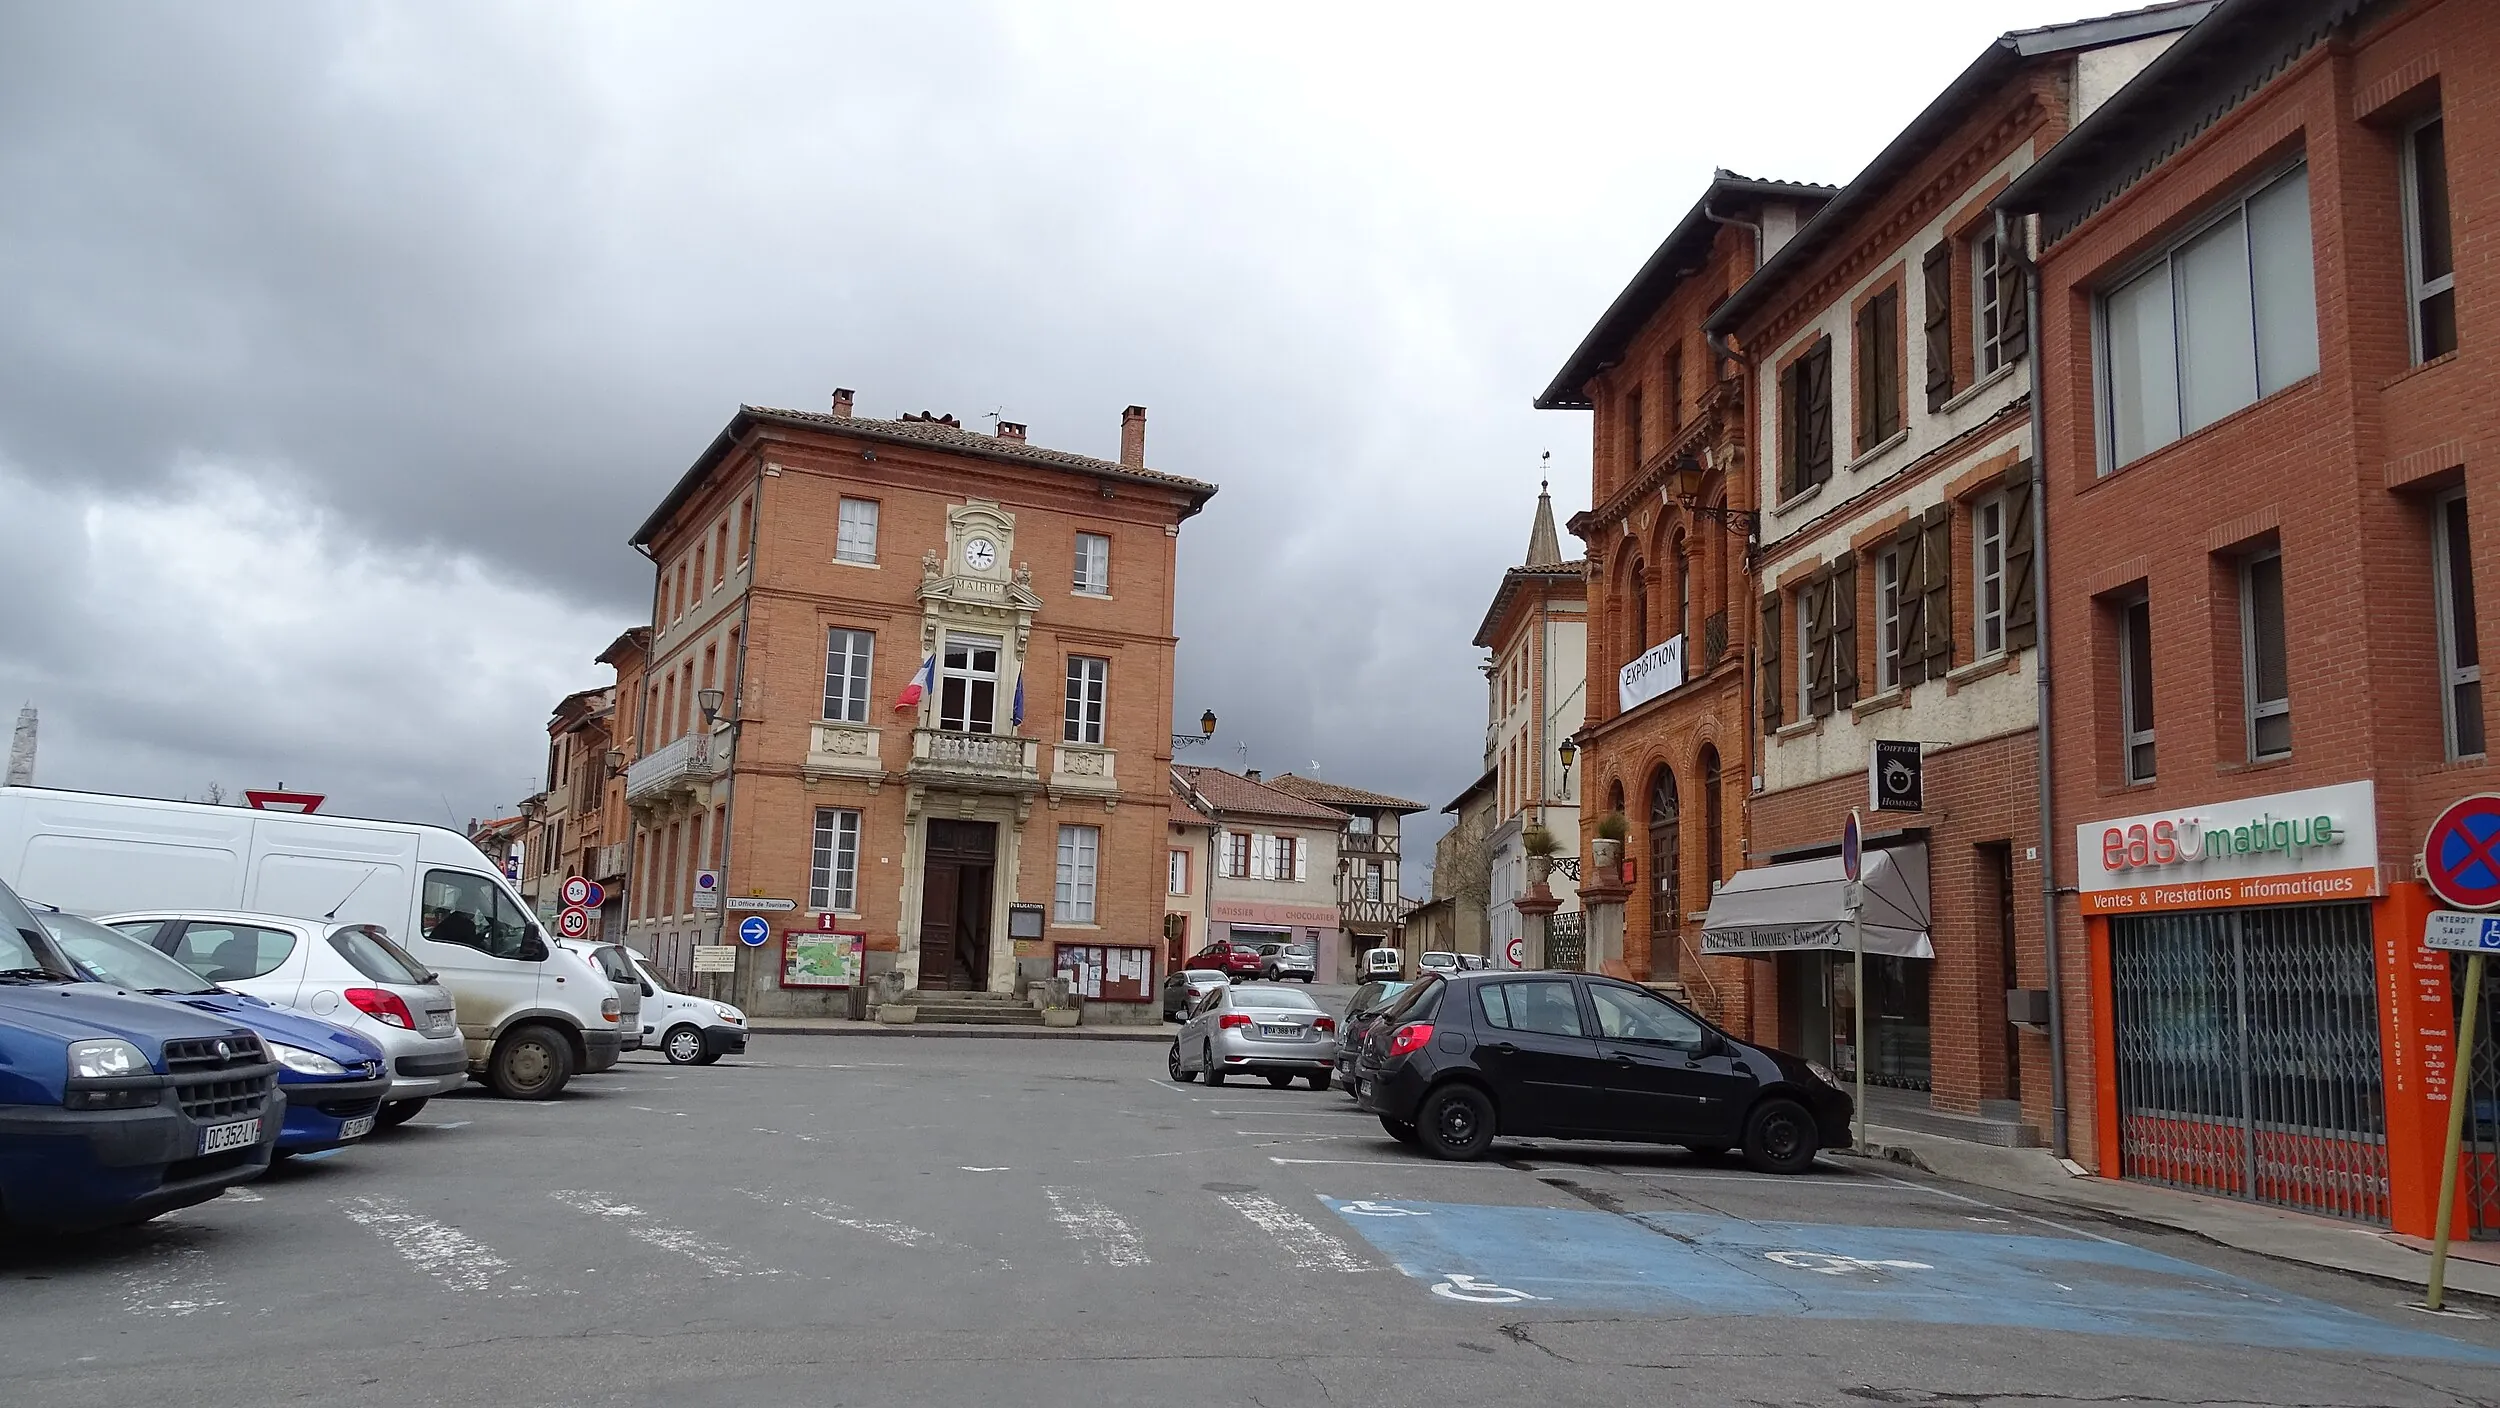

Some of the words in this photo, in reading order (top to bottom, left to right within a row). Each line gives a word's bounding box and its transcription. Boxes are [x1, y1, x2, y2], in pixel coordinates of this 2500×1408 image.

[957, 579, 1001, 594] MAIRIE
[1625, 642, 1676, 686] EXPOSITION
[1877, 743, 1919, 753] COIFFURE
[1881, 797, 1919, 807] HOMMES
[2094, 894, 2133, 908] Ventes
[2139, 891, 2148, 905] &
[2155, 885, 2232, 904] Prestations
[2240, 876, 2353, 898] informatiques
[738, 900, 756, 908] Office
[766, 901, 791, 909] Tourisme
[1010, 902, 1044, 910] PUBLICATIONS
[1285, 911, 1335, 921] CHOCOLATIER
[2435, 915, 2475, 925] INTERDIT
[565, 915, 583, 929] 30
[2442, 926, 2467, 935] SAUF
[2419, 1028, 2447, 1036] Samedi
[207, 1122, 257, 1150] DC-352-LY
